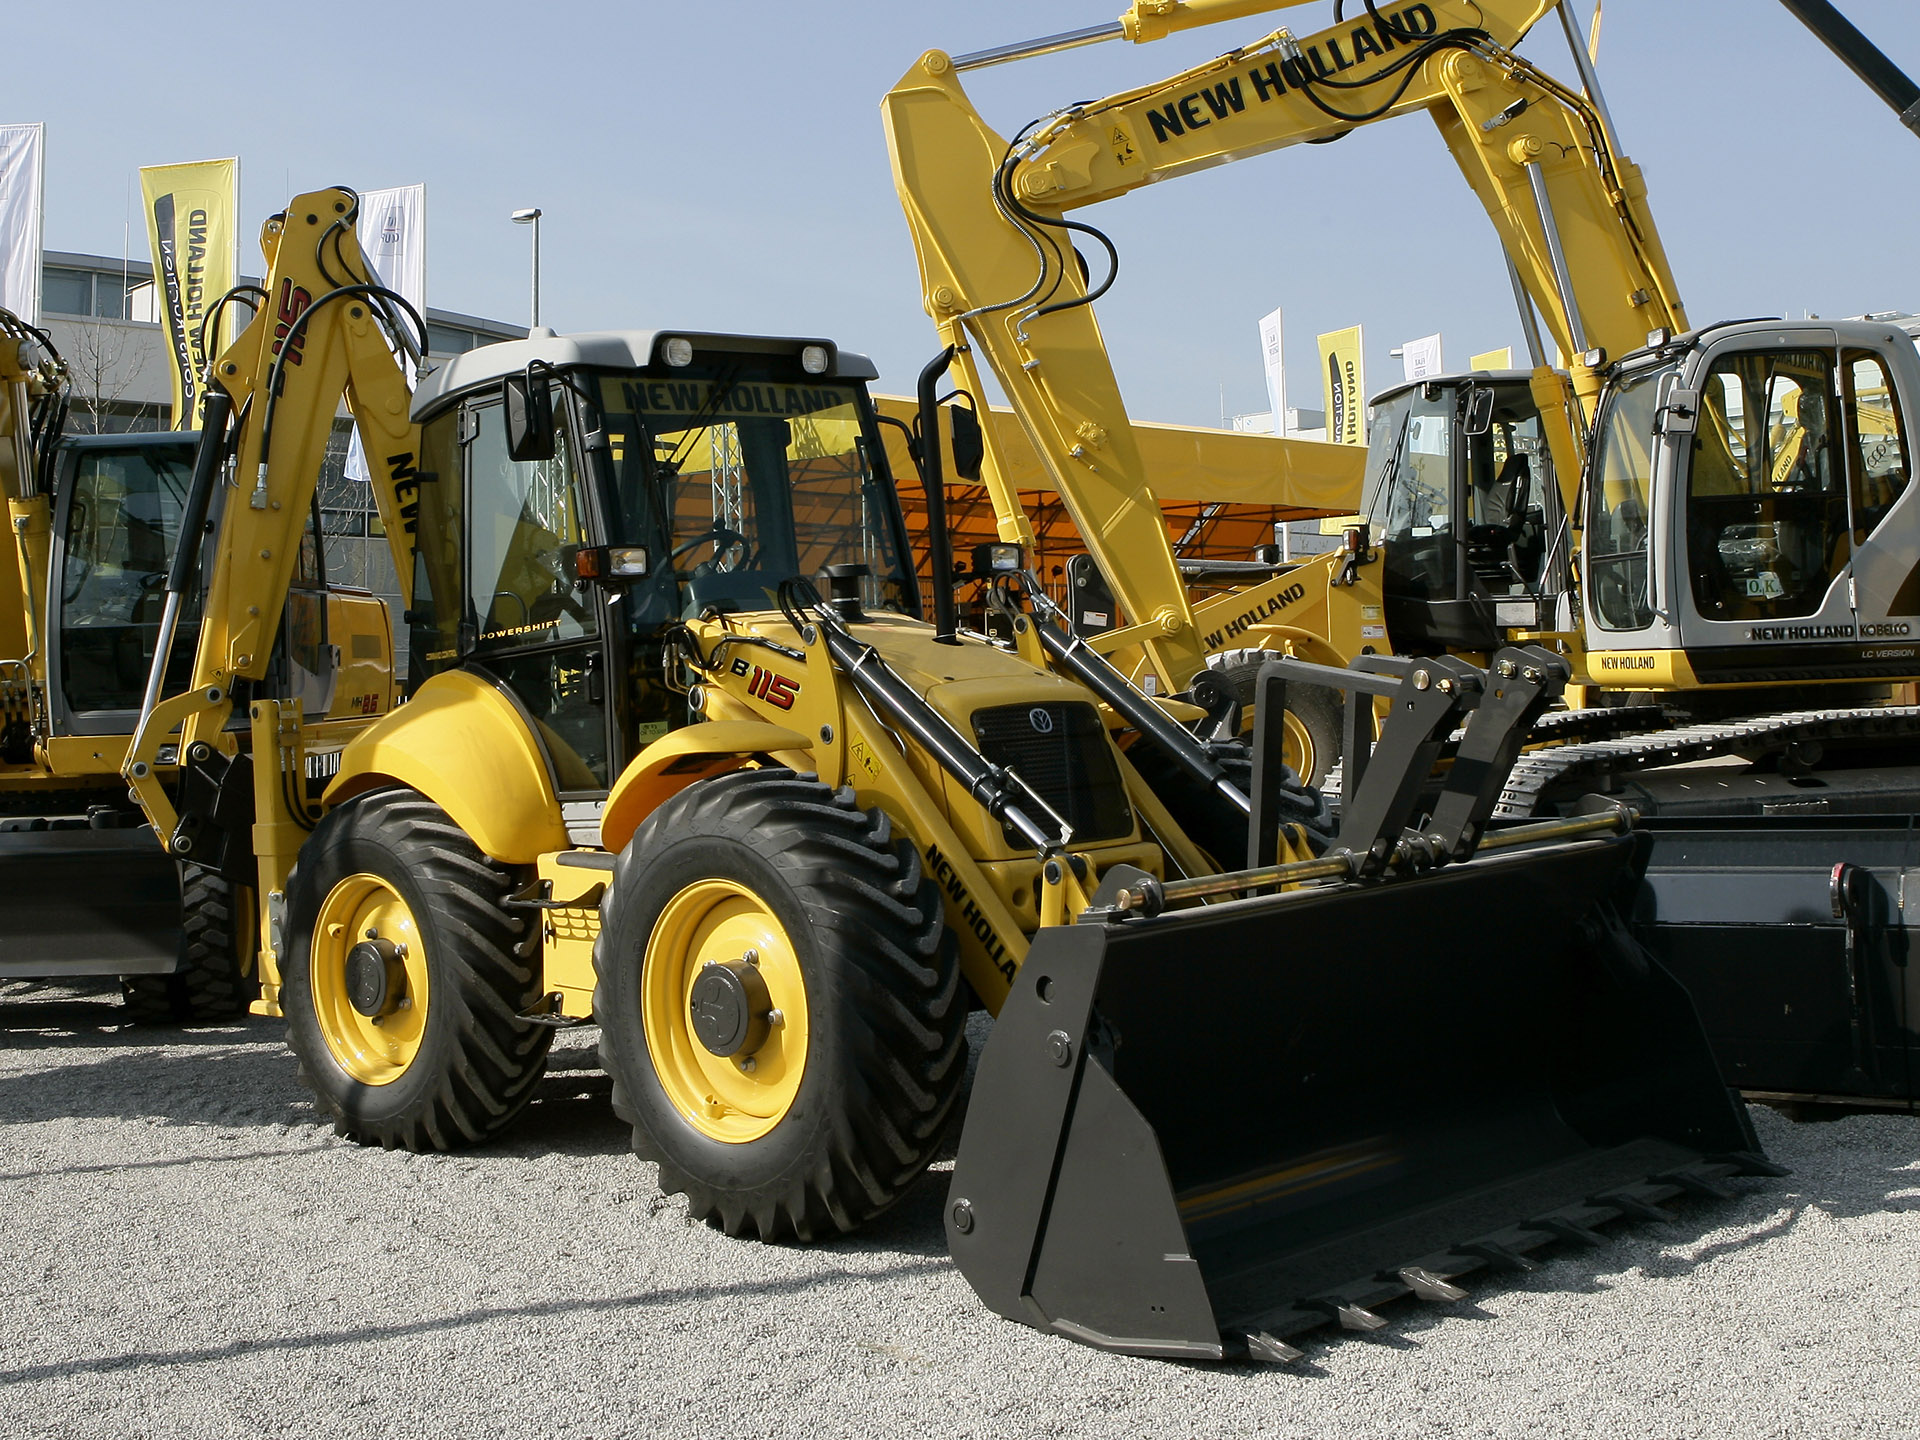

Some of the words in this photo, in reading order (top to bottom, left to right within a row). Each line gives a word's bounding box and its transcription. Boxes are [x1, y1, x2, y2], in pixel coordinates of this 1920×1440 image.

[1146, 77, 1246, 144] NEW
[621, 382, 699, 411] NEW
[705, 385, 842, 414] HOLLAND
[1749, 580, 1779, 593] O.K.
[1224, 583, 1305, 639] HOLLAND
[479, 620, 561, 641] POWERSHIFT
[1752, 627, 1787, 640] NEW
[1788, 624, 1854, 639] HOLLAND
[1860, 623, 1910, 637] KOBELCO
[1601, 657, 1618, 670] NEW
[1619, 656, 1655, 670] HOLLAND
[1861, 650, 1874, 658] LC
[1875, 649, 1915, 658] VERSION
[925, 843, 968, 904] NEW
[962, 899, 1018, 986] HOLLA
